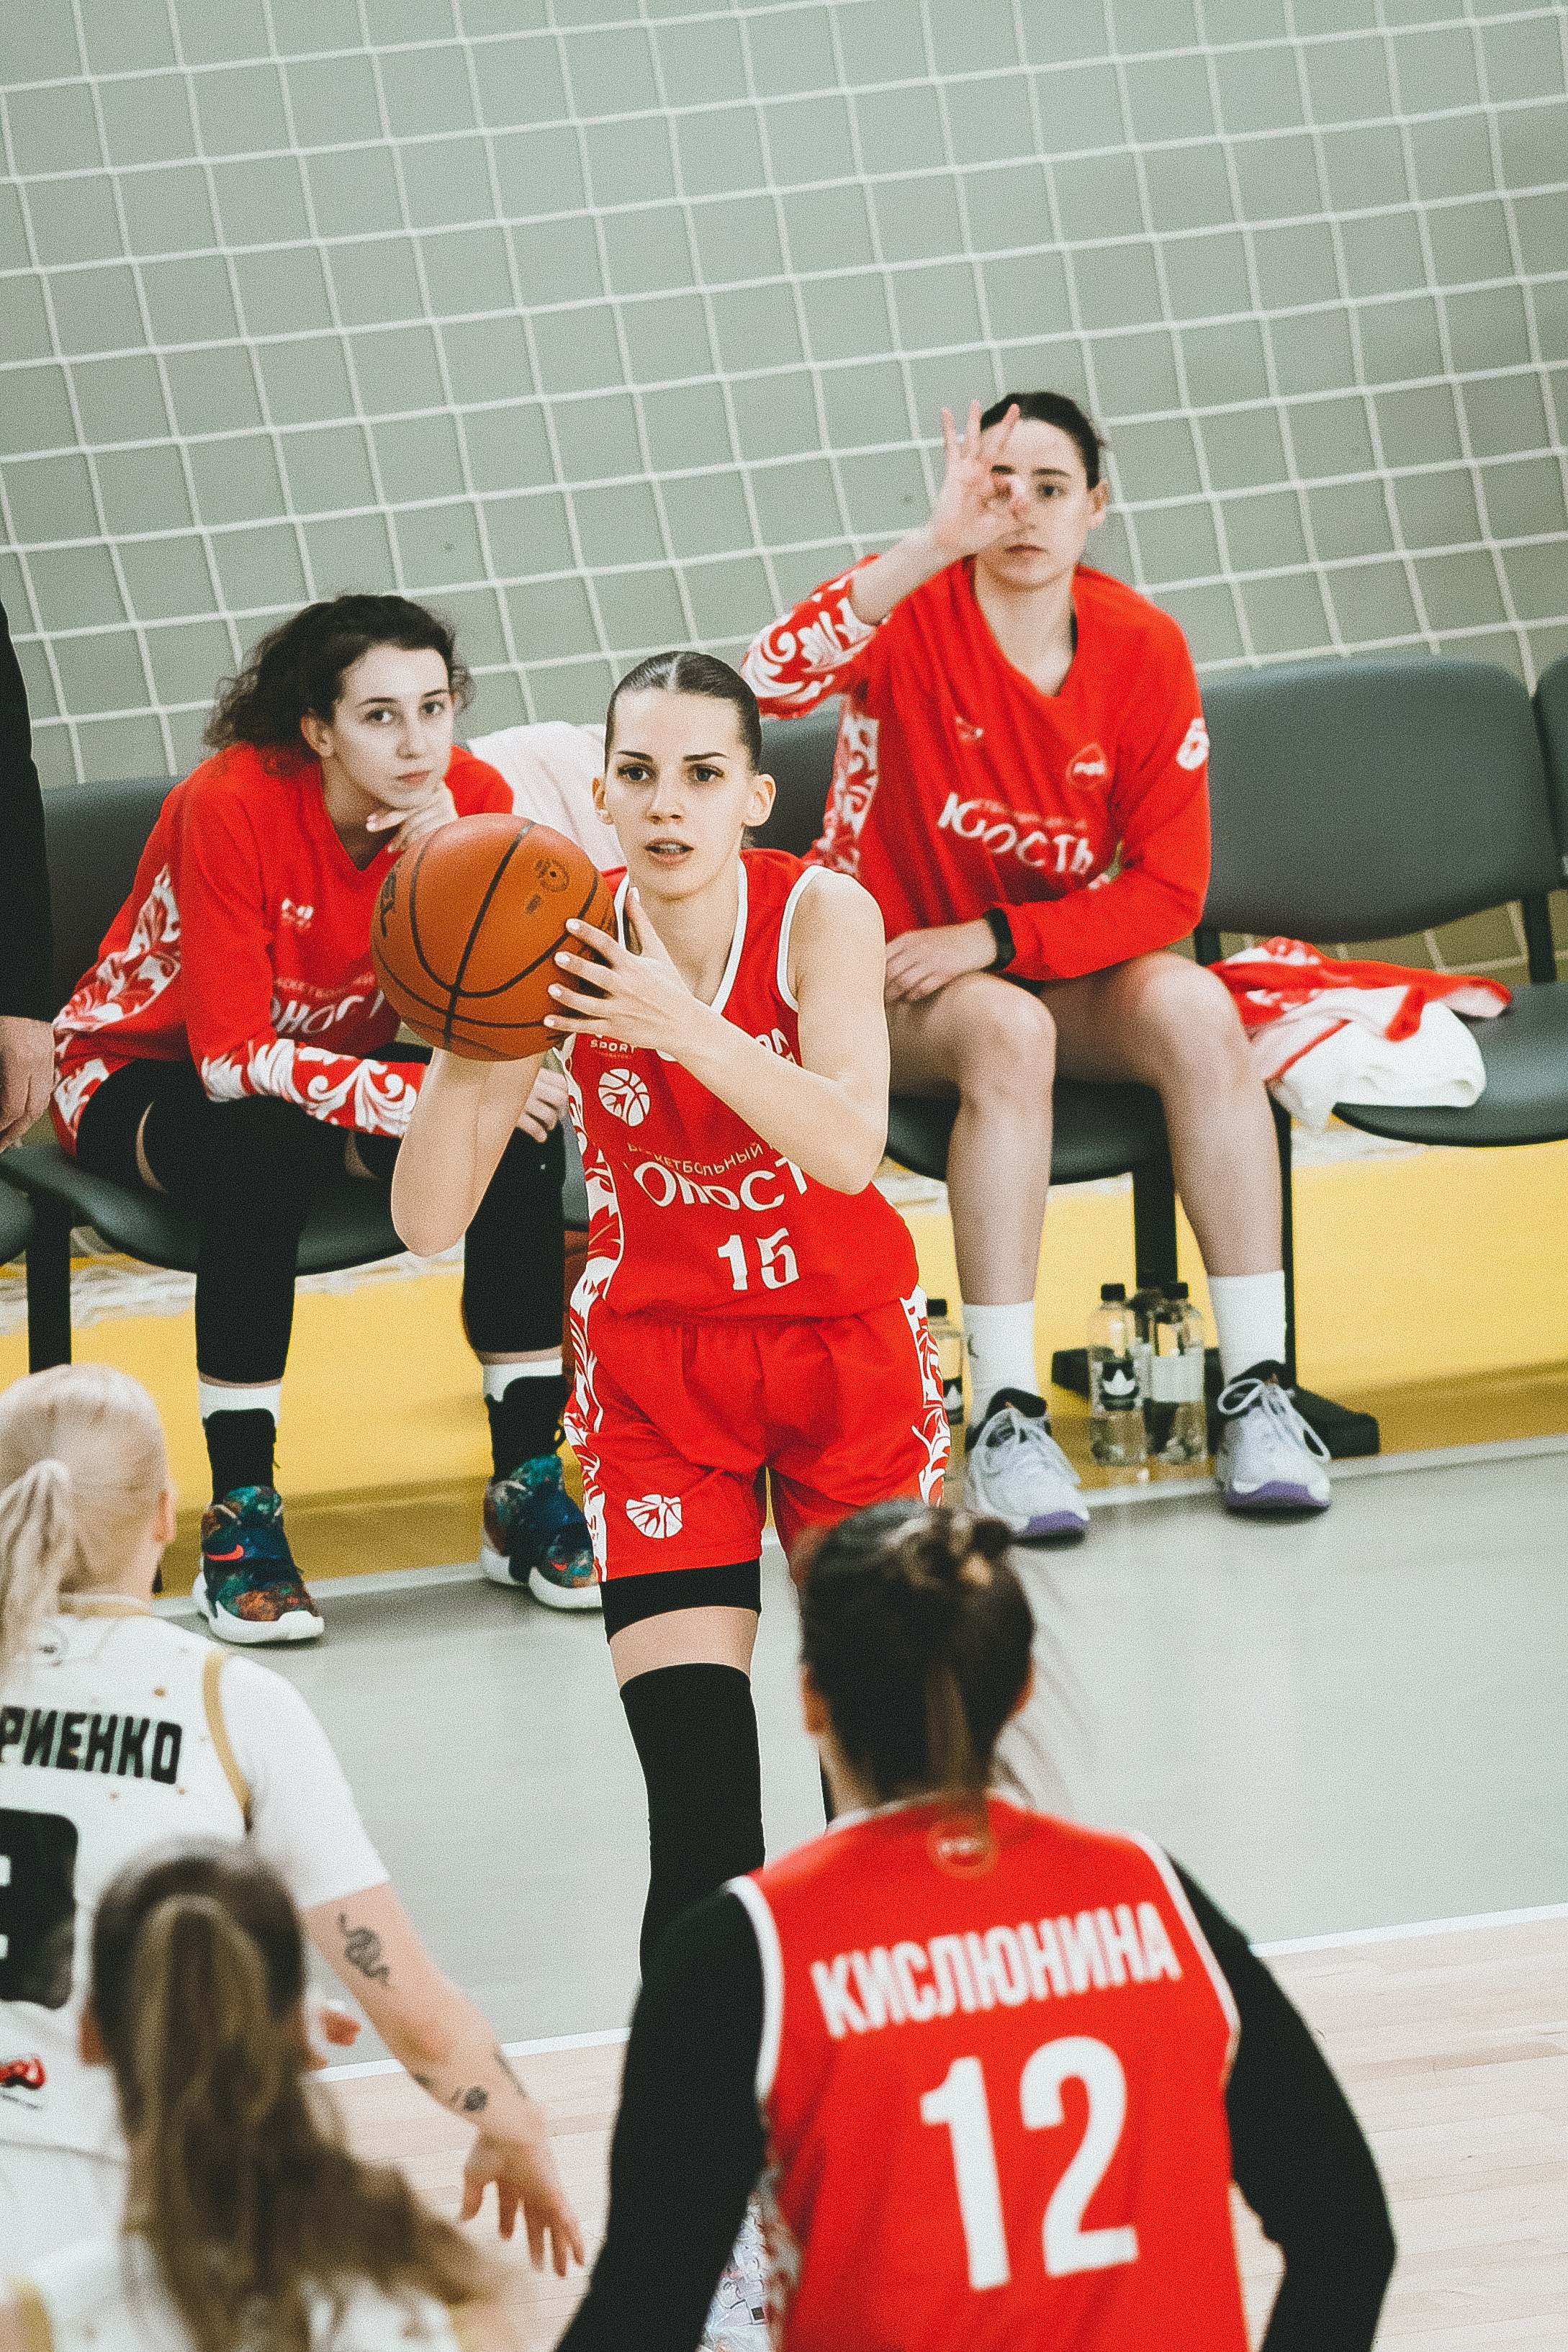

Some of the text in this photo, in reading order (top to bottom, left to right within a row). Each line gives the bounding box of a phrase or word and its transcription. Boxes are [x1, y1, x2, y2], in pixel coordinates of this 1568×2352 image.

[717, 1227, 800, 1291] 15
[811, 1901, 1183, 2040] КИСЛЮНИНА
[920, 2035, 1139, 2291] 12
